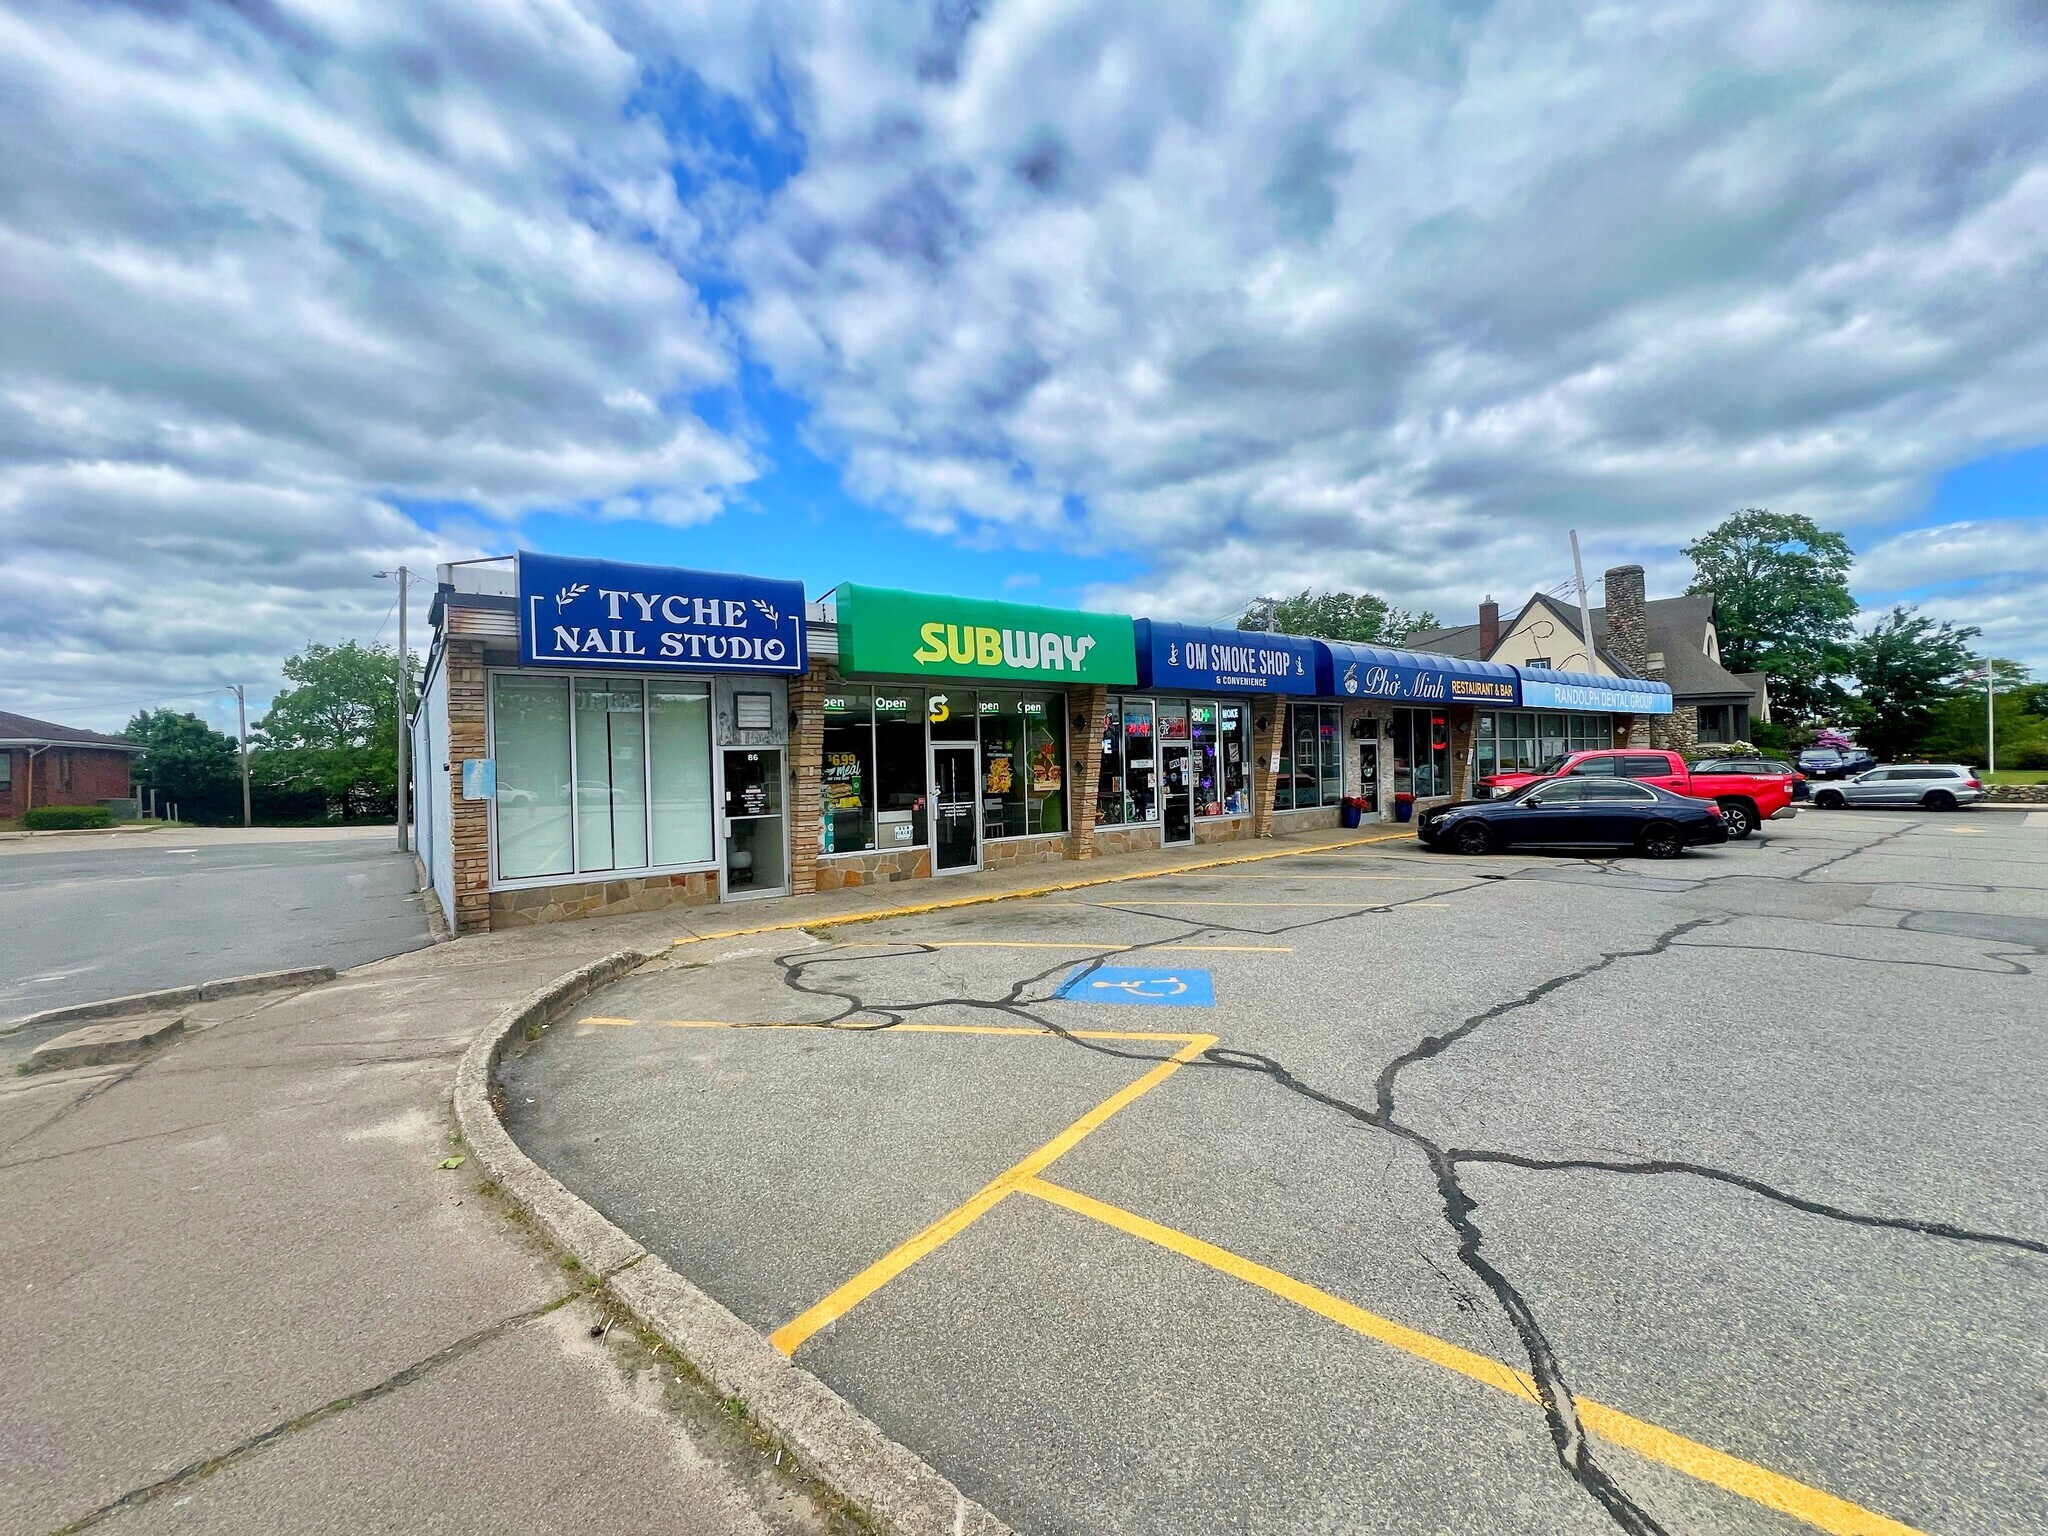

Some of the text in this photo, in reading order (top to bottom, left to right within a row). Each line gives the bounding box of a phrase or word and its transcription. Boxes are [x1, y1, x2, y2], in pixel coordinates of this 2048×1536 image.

[599, 588, 748, 629] TYCHE
[553, 625, 786, 661] NAIL STUDIO
[912, 622, 1097, 671] SUBWAY
[1185, 642, 1290, 676] OM SMOKE SHOP
[1216, 675, 1267, 687] & CONVENIENCE
[1404, 671, 1447, 699] Minh
[1452, 680, 1513, 697] RESTAURANT & BAR
[875, 697, 907, 710] Open
[979, 702, 999, 712] pen
[1554, 687, 1653, 709] RANDOLPH DENTAL GROUP
[747, 753, 759, 761] 86
